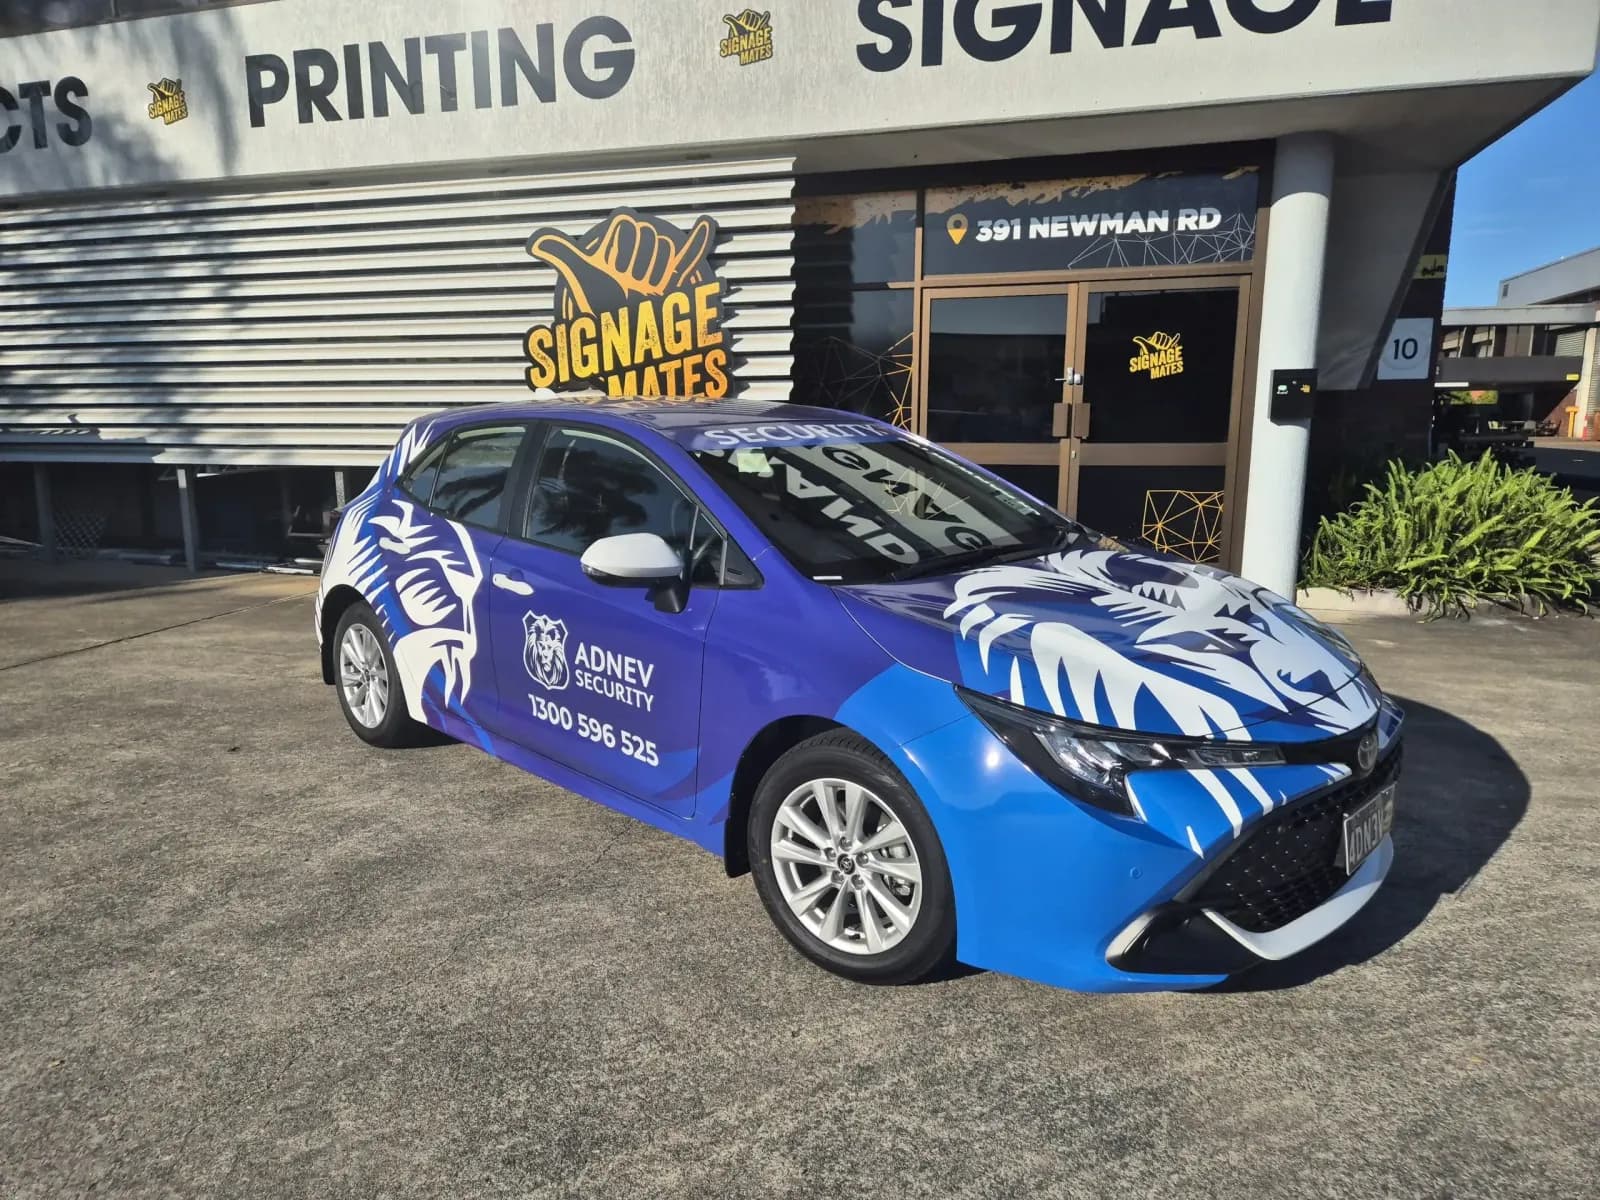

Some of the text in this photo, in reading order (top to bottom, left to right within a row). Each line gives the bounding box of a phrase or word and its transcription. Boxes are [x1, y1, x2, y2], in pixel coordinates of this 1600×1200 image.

[720, 27, 772, 57] SIGNAGE
[856, 0, 1392, 73] SIGN
[741, 44, 773, 65] MATES
[245, 15, 635, 128] PRINTING
[149, 92, 184, 118] SIGNAGE
[164, 107, 186, 122] MATES
[976, 207, 1222, 243] 391 NEWMAN RD
[528, 282, 723, 389] SIGNAGE
[1393, 338, 1418, 360] 10
[1129, 346, 1183, 373] SIGNAGE
[1150, 361, 1184, 380] MATES
[703, 424, 883, 447] SECURITY
[574, 642, 654, 688] ADNEV
[575, 669, 654, 712] SECURITY
[528, 693, 659, 767] 1300 596 525
